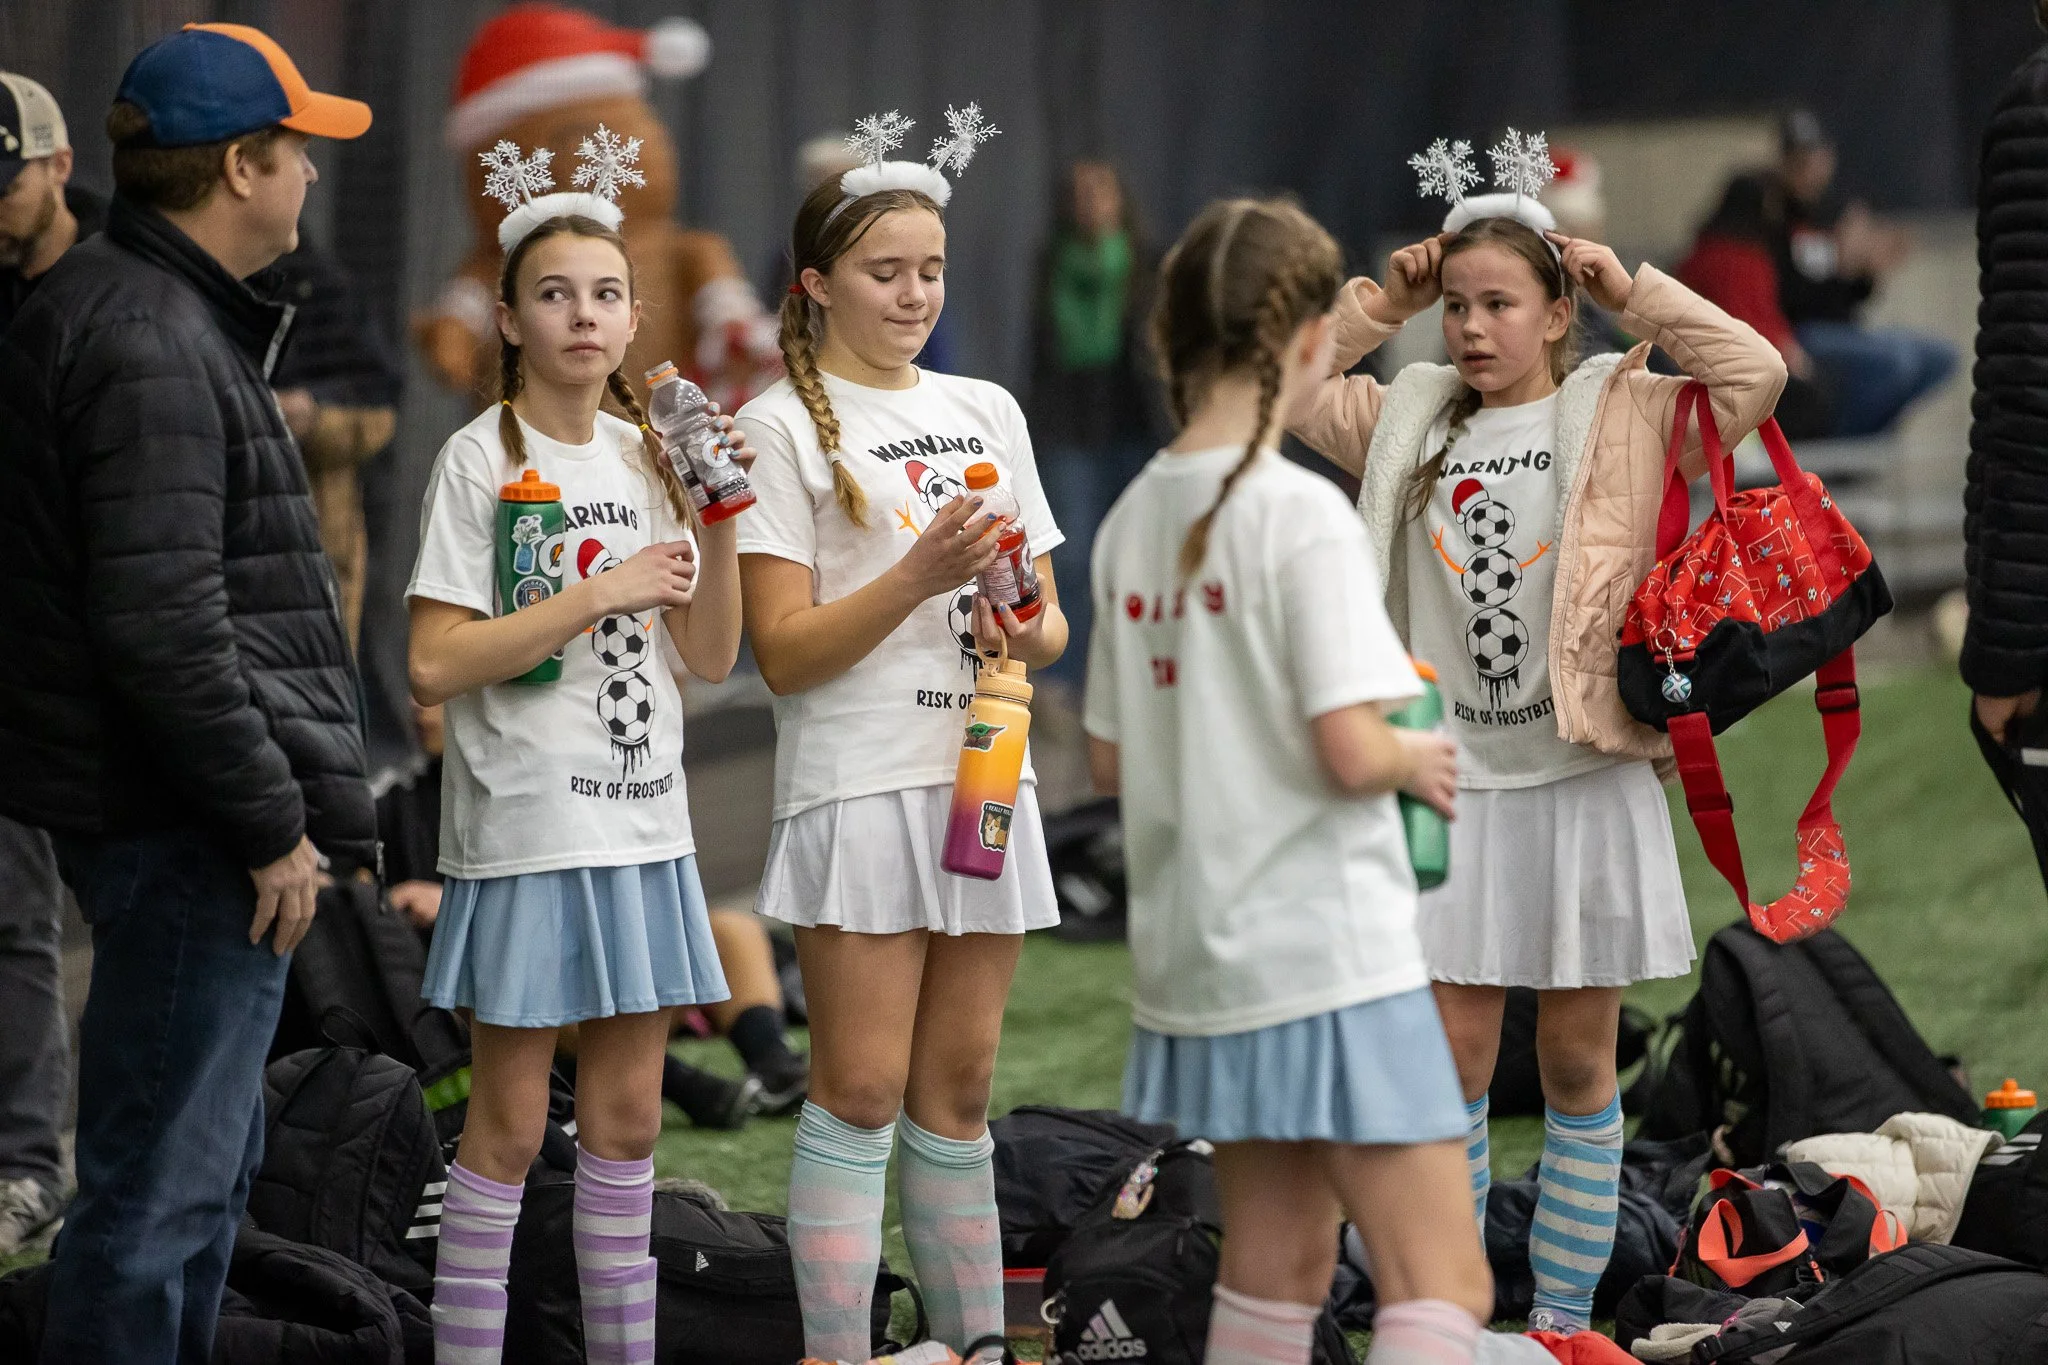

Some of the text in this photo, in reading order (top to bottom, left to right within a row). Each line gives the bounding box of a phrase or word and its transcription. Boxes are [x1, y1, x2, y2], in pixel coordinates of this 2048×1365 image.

[868, 434, 984, 462] WARNING
[564, 502, 637, 532] ARNING
[917, 689, 974, 709] RISK OF
[1455, 696, 1555, 726] RISK OF FROSTBIT
[571, 775, 602, 798] RISK
[606, 782, 622, 800] OF
[1077, 1338, 1148, 1361] adidas
